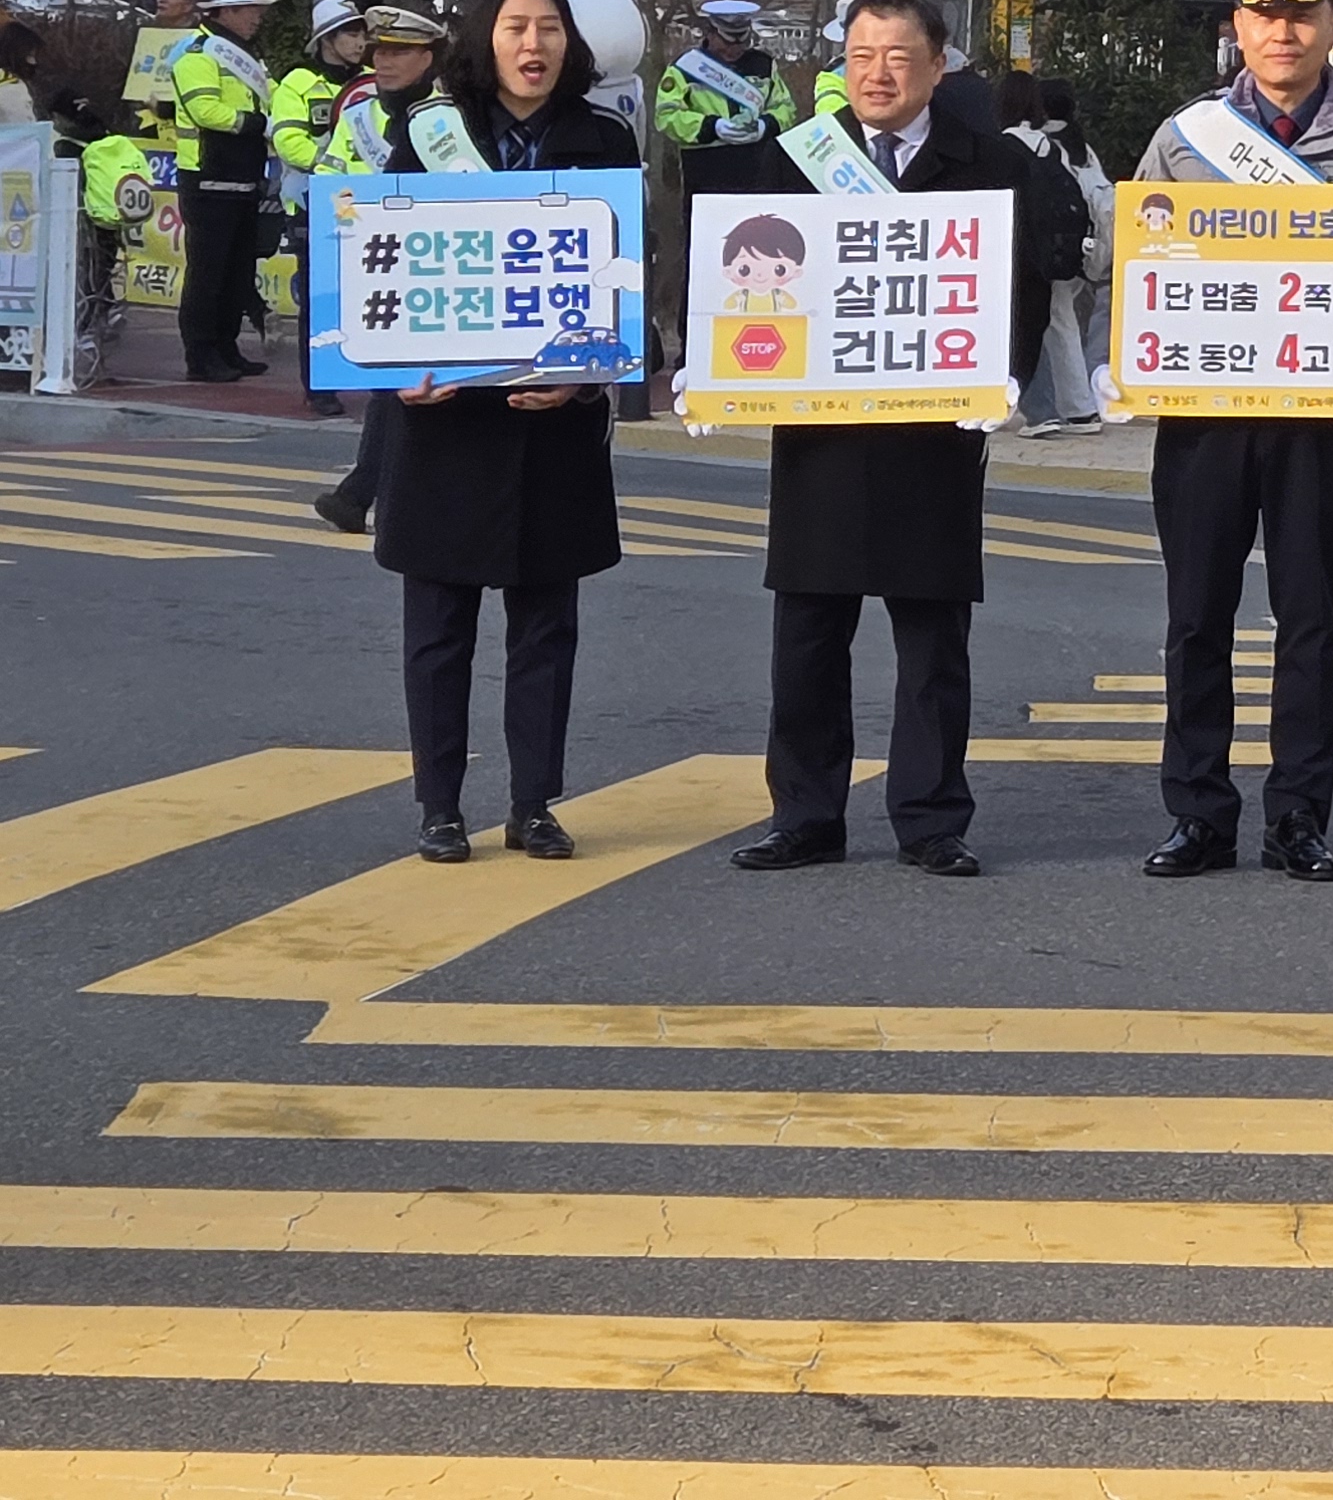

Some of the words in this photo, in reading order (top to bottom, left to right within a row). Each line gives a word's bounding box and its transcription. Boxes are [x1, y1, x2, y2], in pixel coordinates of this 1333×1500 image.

[124, 188, 150, 210] 30
[836, 217, 980, 263] 멈춰서
[1188, 208, 1277, 240] 어린이
[362, 228, 590, 276] #안전운전
[362, 283, 591, 332] #안전보행
[833, 274, 980, 318] 살피고
[1142, 271, 1194, 312] 1단
[1202, 281, 1259, 312] 멈춤
[1278, 272, 1332, 313] 2쪽
[740, 341, 777, 355] STOP
[832, 328, 978, 374] 건너요
[1136, 331, 1190, 372] 3초
[1199, 343, 1258, 373] 동안
[1275, 333, 1330, 374] 4고
